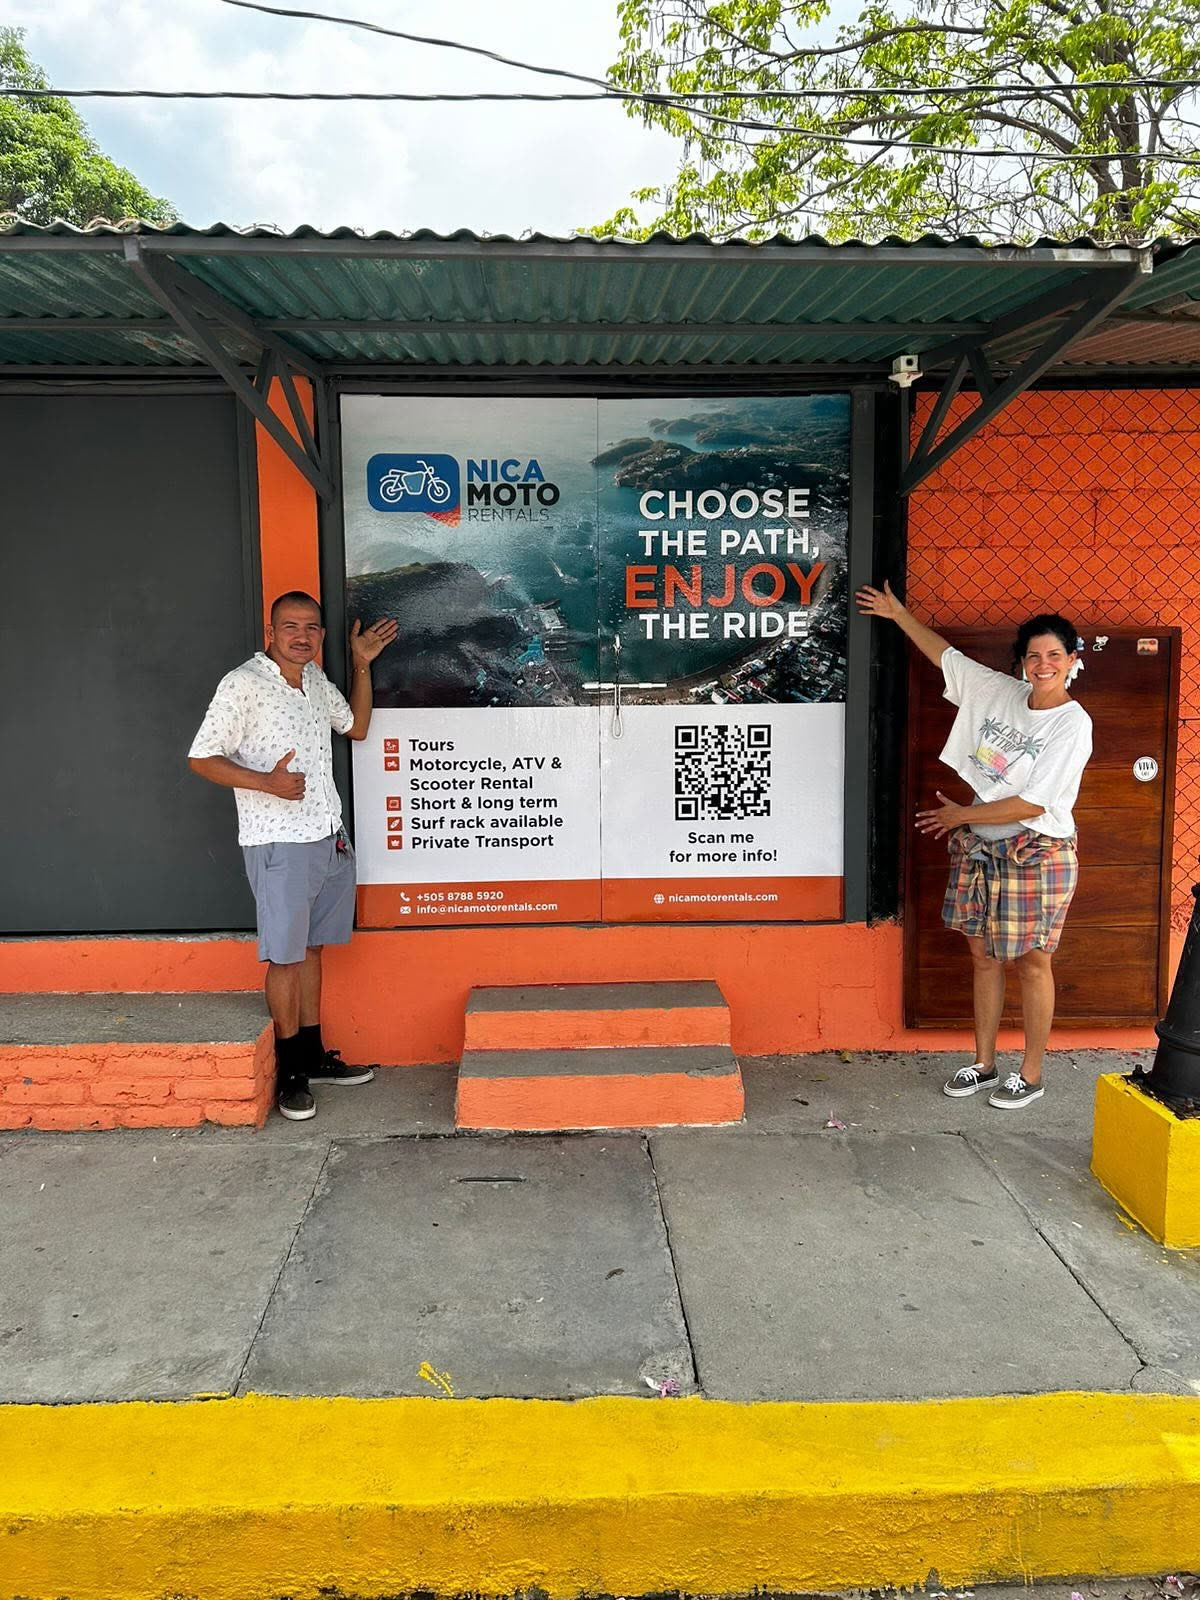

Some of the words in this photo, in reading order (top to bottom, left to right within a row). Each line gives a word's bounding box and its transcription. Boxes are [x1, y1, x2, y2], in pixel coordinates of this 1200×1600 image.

[467, 459, 545, 482] NICA
[468, 483, 560, 506] MOTO
[639, 488, 811, 520] CHOOSE
[468, 508, 550, 522] RENTALS
[638, 530, 707, 556] THE
[720, 528, 820, 558] PATH,
[625, 562, 826, 608] ENJOY
[638, 613, 710, 639] THE
[723, 611, 809, 639] RIDE
[409, 739, 454, 752] Tours
[410, 757, 507, 772] Motorcycle,
[512, 757, 546, 770] ATV
[551, 757, 562, 769] &
[1138, 762, 1154, 770] VIVA
[410, 778, 475, 791] Scooter
[481, 776, 533, 790] Rental
[410, 797, 456, 810] Short
[461, 797, 472, 809] &
[478, 796, 514, 812] long
[519, 796, 558, 809] term
[411, 816, 446, 829] Surf
[450, 816, 485, 829] rack
[490, 815, 563, 828] available
[411, 836, 470, 849] Private
[475, 834, 555, 849] Transport
[687, 832, 725, 844] Scan
[730, 833, 754, 843] me
[669, 850, 692, 862] for
[697, 851, 738, 862] more
[742, 849, 778, 862] info!
[416, 892, 445, 902] +505
[447, 892, 473, 901] 8788
[477, 891, 504, 901] 5920
[668, 893, 778, 902] nicamotorentals.com
[417, 903, 557, 914] info@nicamotorentals.com
